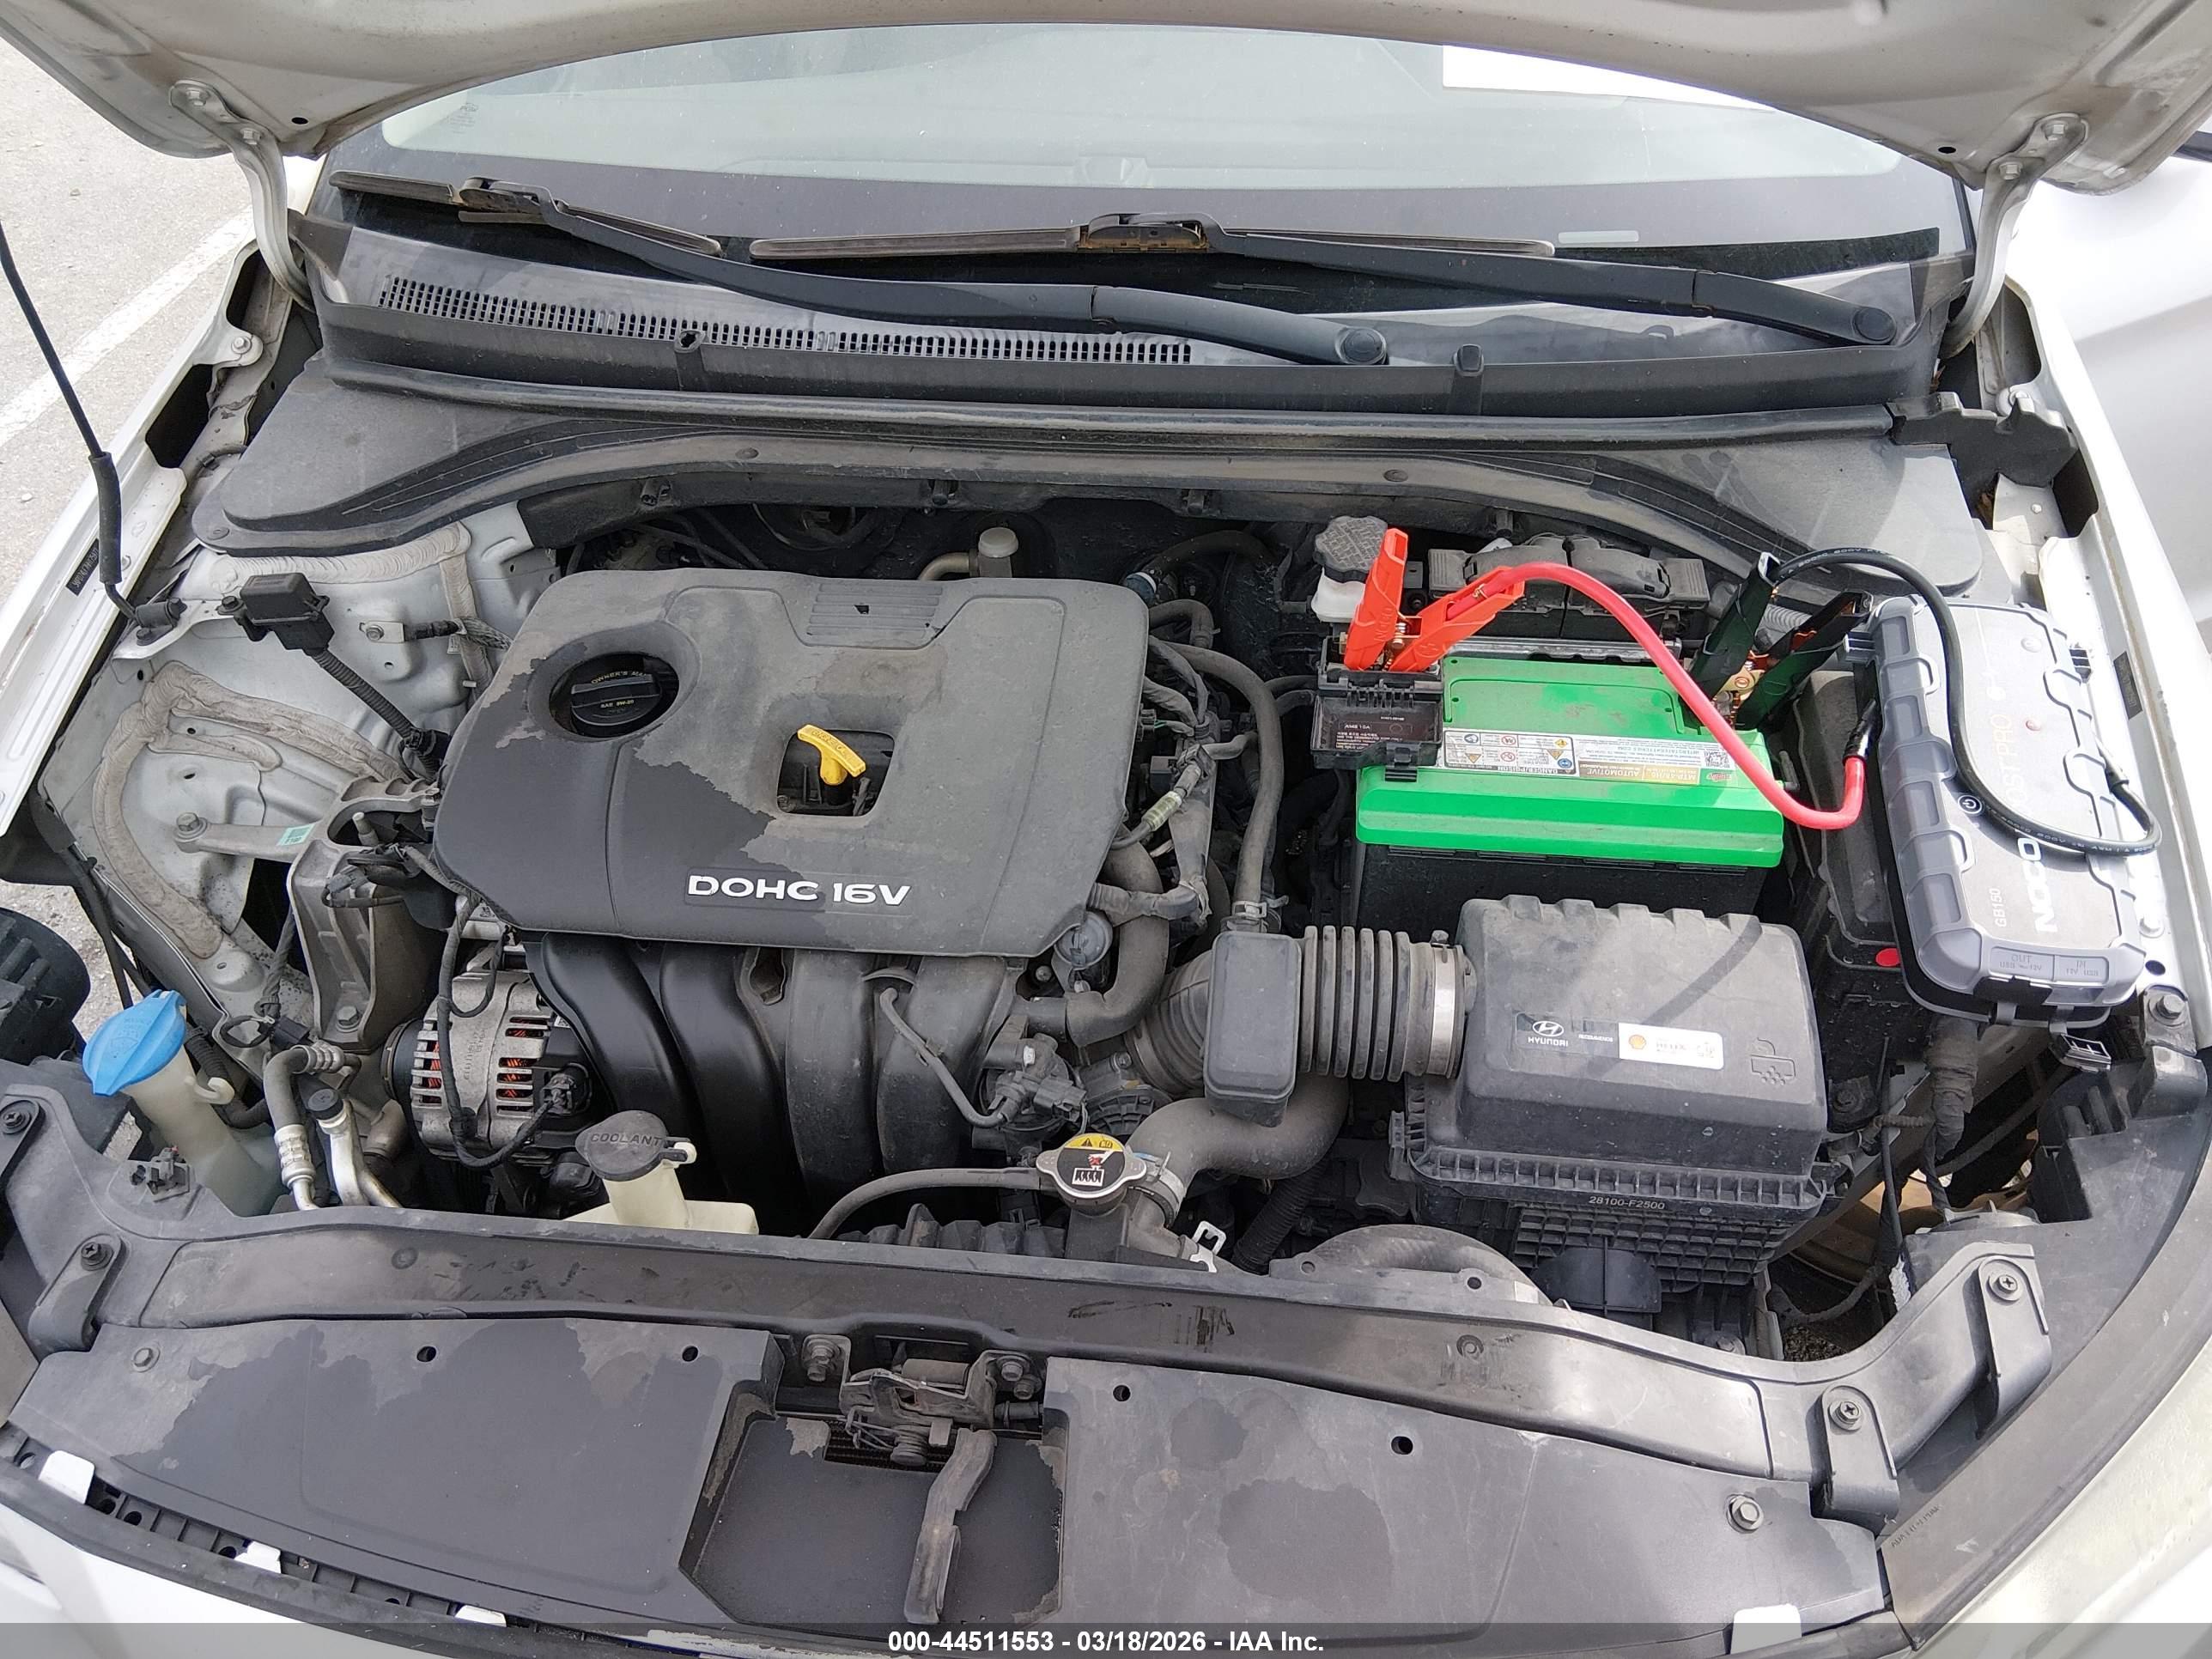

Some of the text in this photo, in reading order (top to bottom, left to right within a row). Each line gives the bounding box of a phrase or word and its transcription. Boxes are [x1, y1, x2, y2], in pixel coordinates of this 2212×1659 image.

[591, 670, 628, 684] OWNER'S
[1587, 767, 1640, 777] AUTOMOTIVE
[688, 875, 912, 906] DOHC 16V
[2017, 837, 2059, 933] NOCO
[1989, 887, 2007, 927] GB150
[2011, 953, 2033, 963] OUT
[2075, 959, 2087, 969] IN
[1528, 1036, 1569, 1048] HYUNDAI
[590, 1133, 663, 1147] COOLANT
[1589, 1195, 1665, 1210] 28100-F2500
